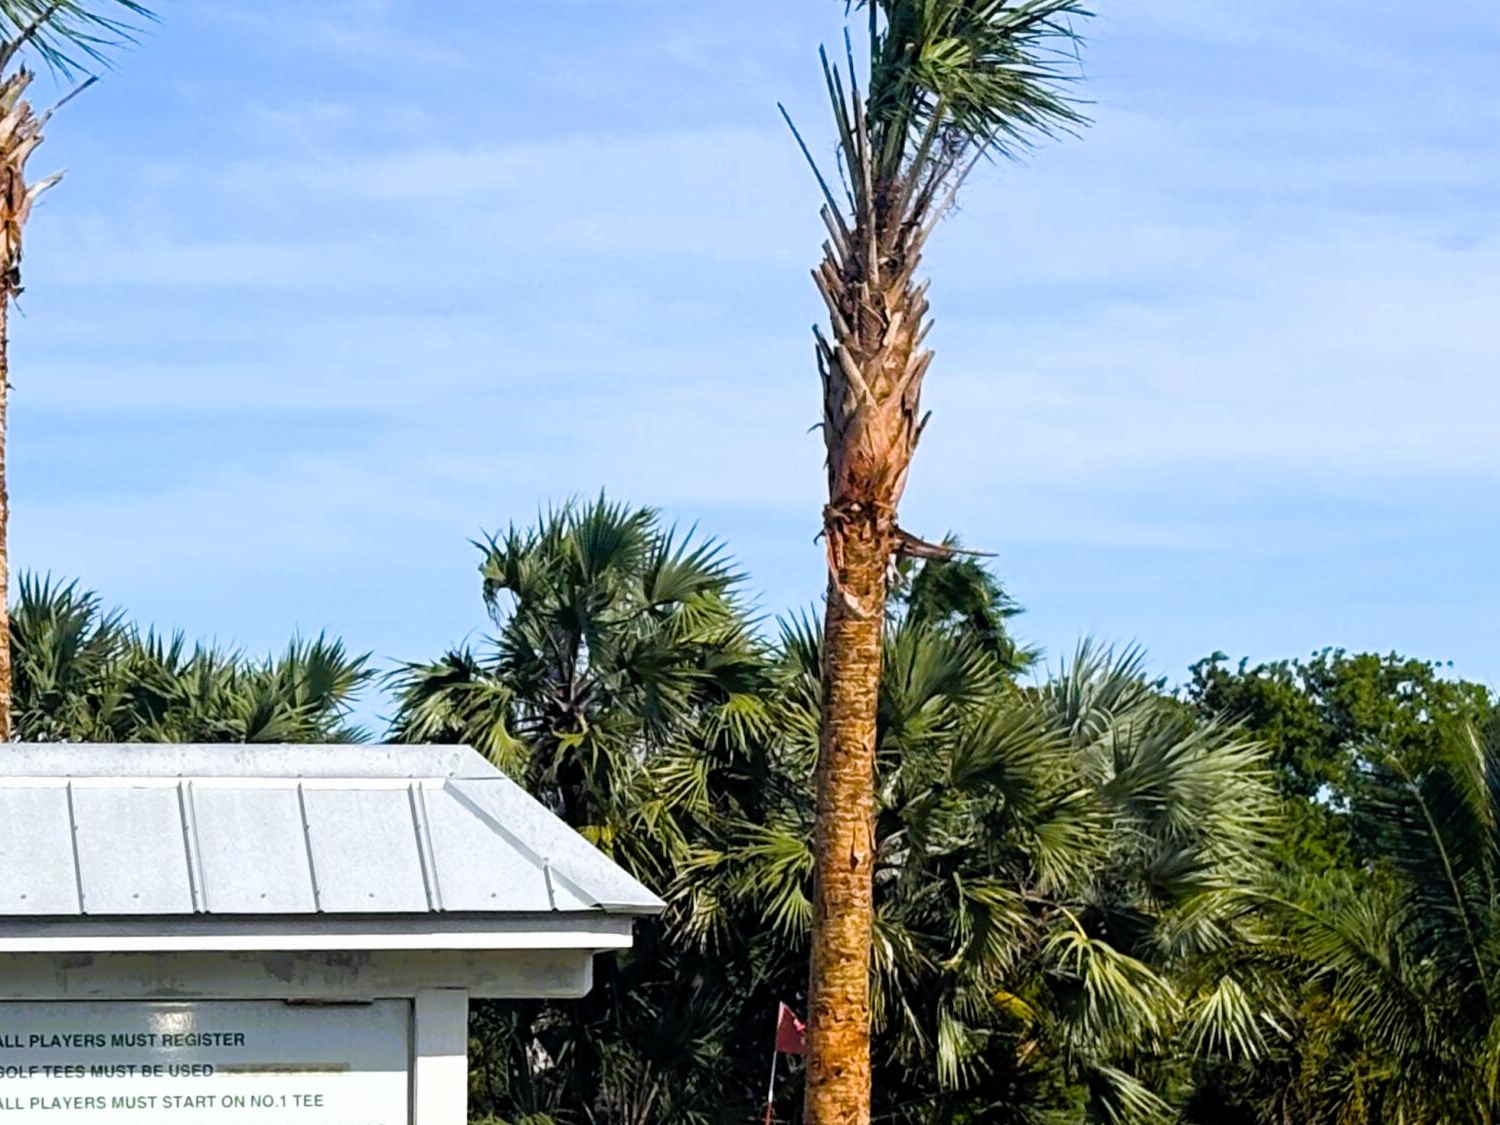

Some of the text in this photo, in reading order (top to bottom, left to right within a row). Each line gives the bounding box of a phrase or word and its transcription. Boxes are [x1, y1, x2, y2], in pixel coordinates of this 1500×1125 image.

[29, 1034, 106, 1048] PLAYERS
[111, 1033, 158, 1047] MUST
[162, 1032, 246, 1048] REGISTER
[43, 1065, 86, 1079] TEES
[90, 1064, 137, 1078] MUST
[142, 1064, 164, 1077] BE
[168, 1063, 214, 1078] USED
[30, 1096, 106, 1110] PLAYERS
[112, 1096, 157, 1109] MUST
[163, 1095, 216, 1109] START
[221, 1095, 245, 1108] ON
[251, 1094, 286, 1108] NO.1
[293, 1094, 324, 1107] TEE
